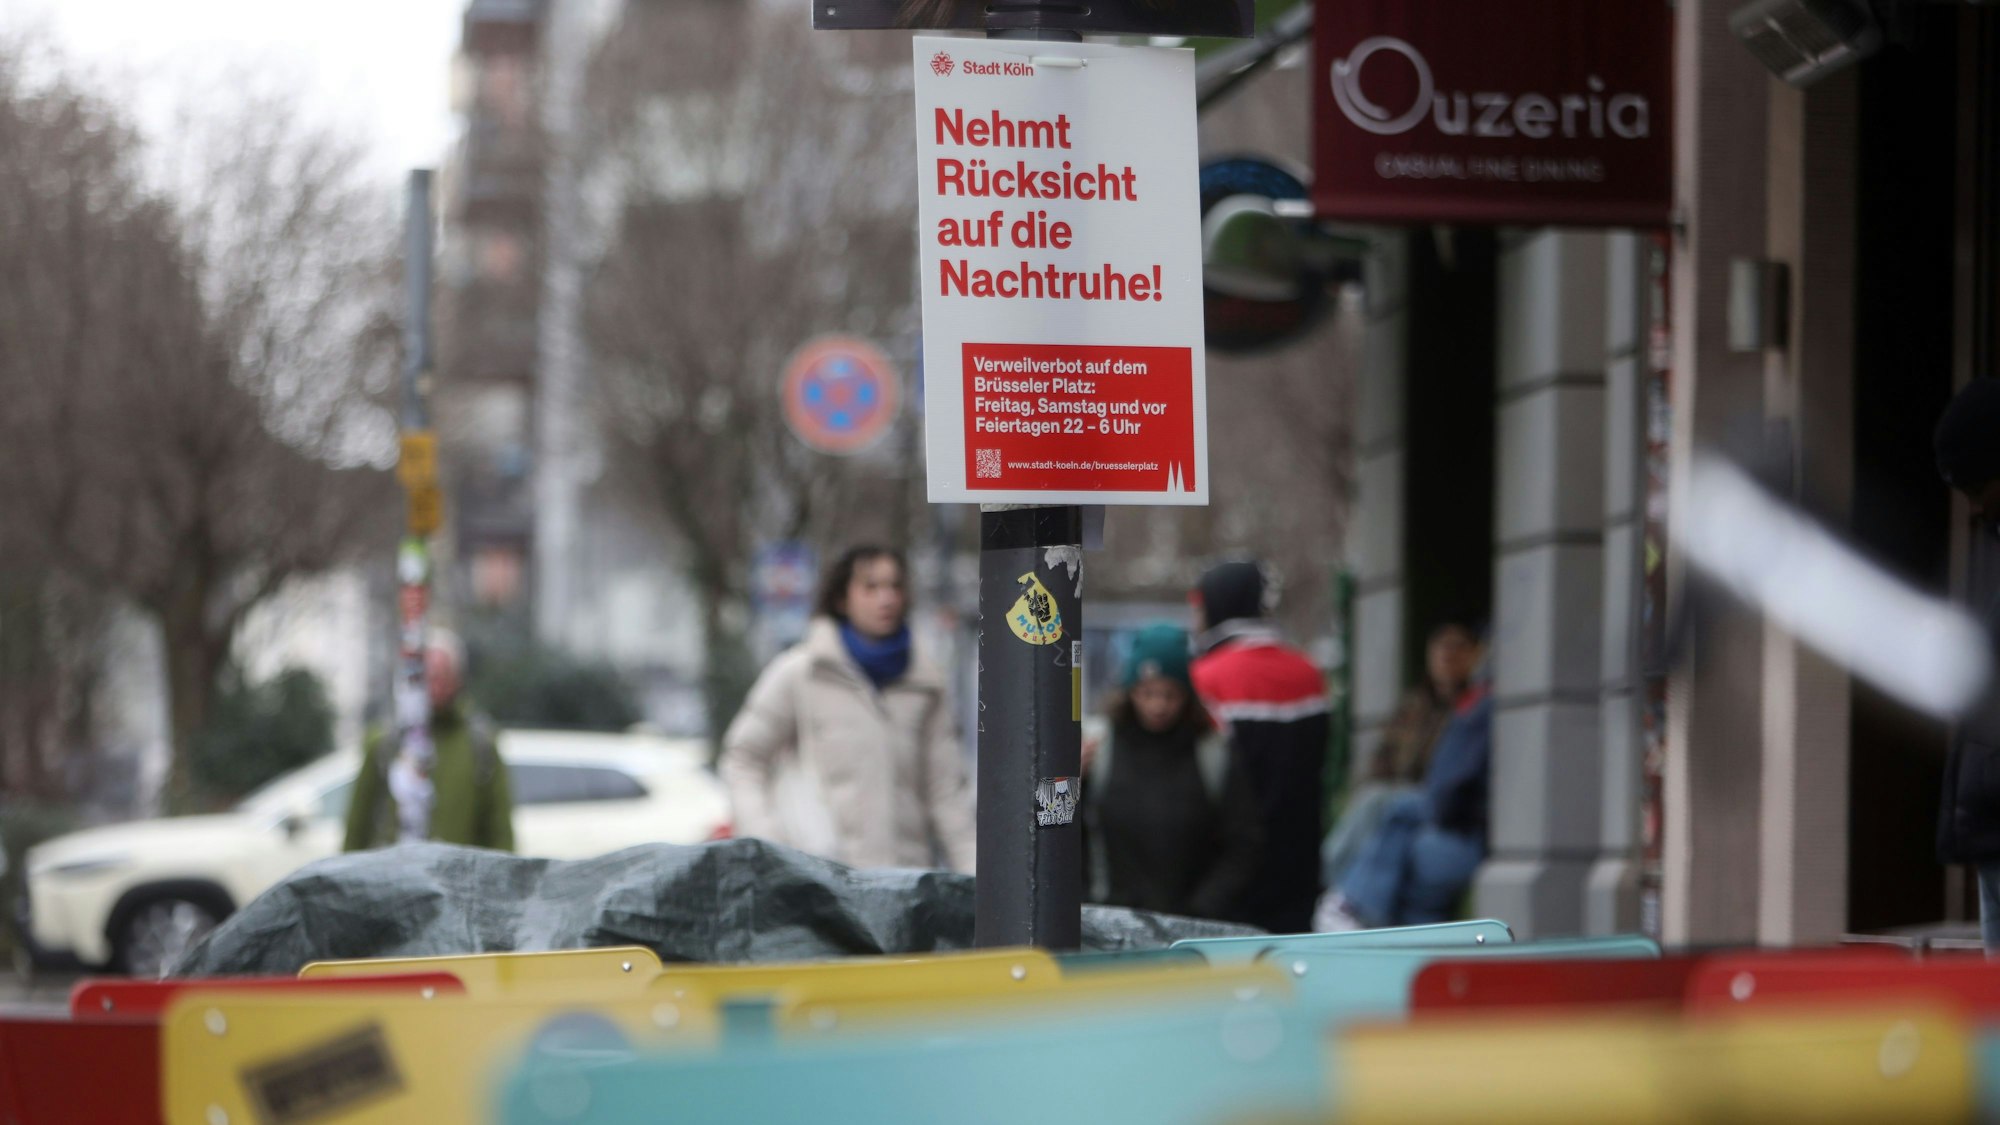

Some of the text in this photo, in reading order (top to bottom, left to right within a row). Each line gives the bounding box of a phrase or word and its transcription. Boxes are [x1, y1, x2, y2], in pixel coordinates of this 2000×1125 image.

[963, 60, 1034, 76] Stadt Köln
[1330, 36, 1649, 138] Ouzeria
[935, 108, 1072, 149] Nehmt
[936, 158, 1137, 201] Rücksicht
[937, 210, 1072, 249] auf die
[940, 259, 1162, 302] Nachtruhe!
[973, 356, 1147, 375] Verweilverbot auf dem
[974, 377, 1096, 394] Brüsseler Platz:
[975, 397, 1167, 418] Freitag, Samstag und vor
[975, 417, 1060, 437] Feiertagen
[1063, 418, 1084, 434] 22
[1099, 419, 1110, 435] 6
[1113, 419, 1141, 435] Uhr
[1007, 460, 1159, 473] www.stadt-koeln.de/bruesselerplatz
